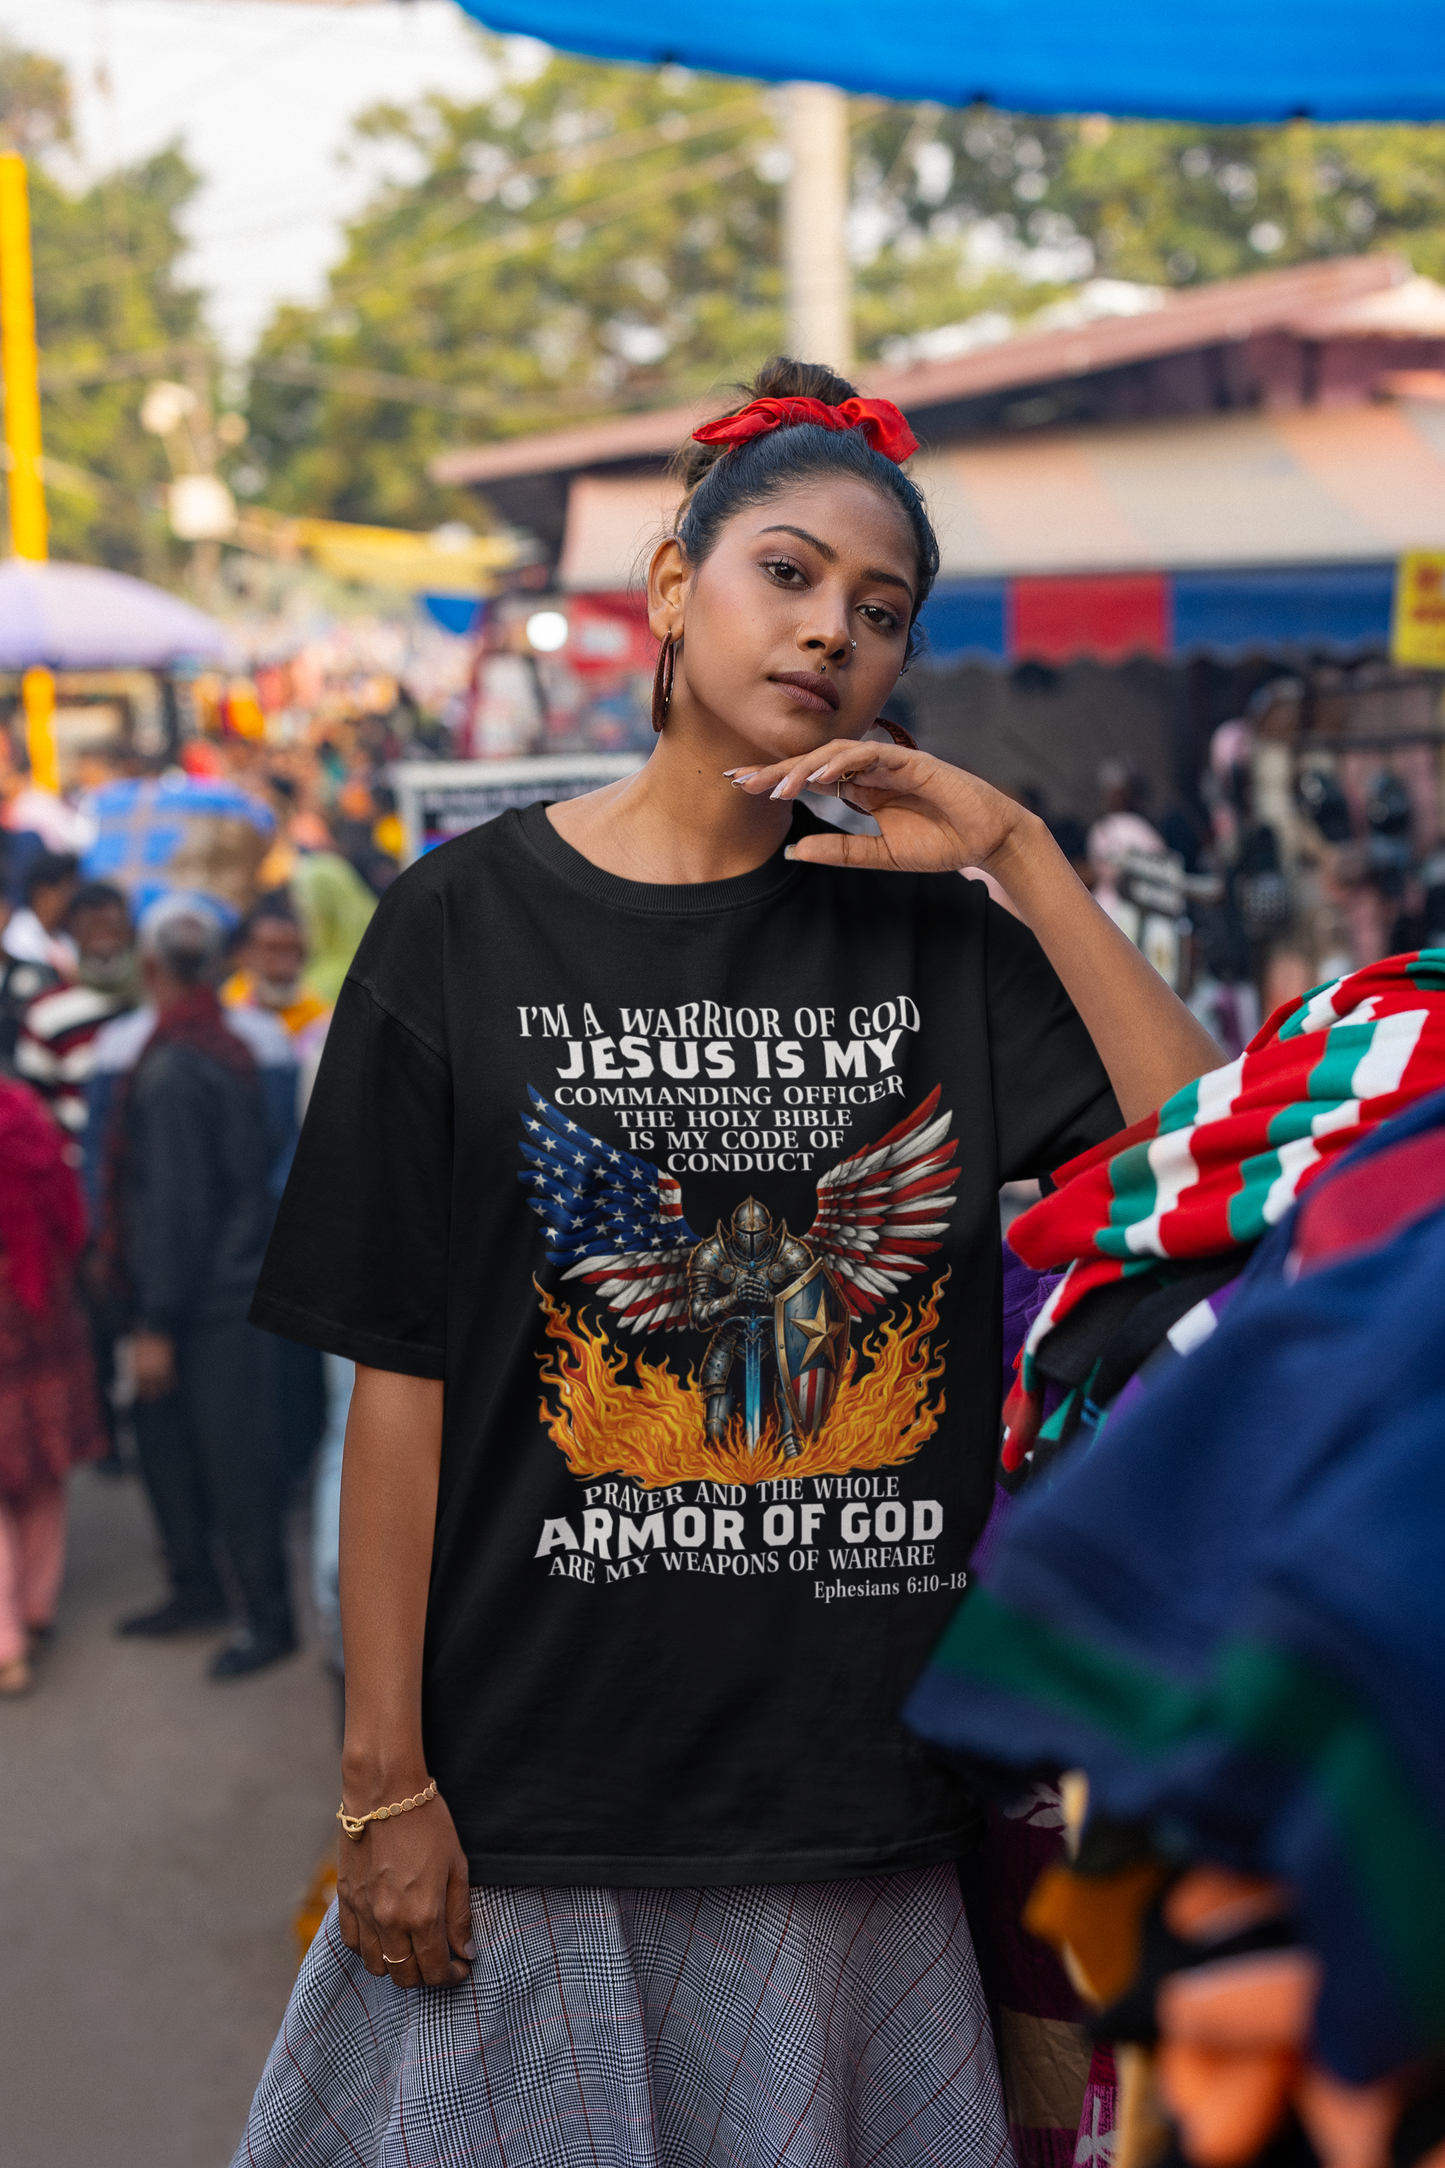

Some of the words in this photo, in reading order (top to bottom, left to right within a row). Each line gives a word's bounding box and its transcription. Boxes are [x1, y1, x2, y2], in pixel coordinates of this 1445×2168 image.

[517, 1003, 573, 1037] I'M
[583, 1002, 604, 1037] A
[619, 1000, 783, 1038] WARRIOR
[794, 1007, 835, 1037] OF
[849, 995, 920, 1037] GOD
[556, 1035, 736, 1079] JESUS
[755, 1040, 805, 1078] IS
[824, 1029, 903, 1078] MY
[554, 1086, 772, 1106] COMMANDING
[783, 1075, 906, 1105] OFFICER
[615, 1110, 675, 1127] THE
[688, 1110, 762, 1127] HOLY
[773, 1109, 852, 1127] BIBLE
[629, 1131, 655, 1150] IS
[666, 1131, 707, 1150] MY
[720, 1131, 798, 1149] CODE
[809, 1130, 844, 1148] OF
[667, 1153, 814, 1172] CONDUCT
[583, 1482, 685, 1513] PRAYER
[694, 1482, 746, 1506] AND
[756, 1479, 803, 1503] THE
[812, 1477, 900, 1499] WHOLE
[534, 1507, 745, 1559] ARMOR
[762, 1504, 826, 1546] OF
[840, 1501, 943, 1543] GOD
[548, 1555, 595, 1584] ARE
[605, 1555, 650, 1583] MY
[661, 1552, 779, 1575] WEAPONS
[789, 1550, 819, 1571] OF
[828, 1545, 935, 1570] WARFARE
[814, 1580, 900, 1603] Ephesians
